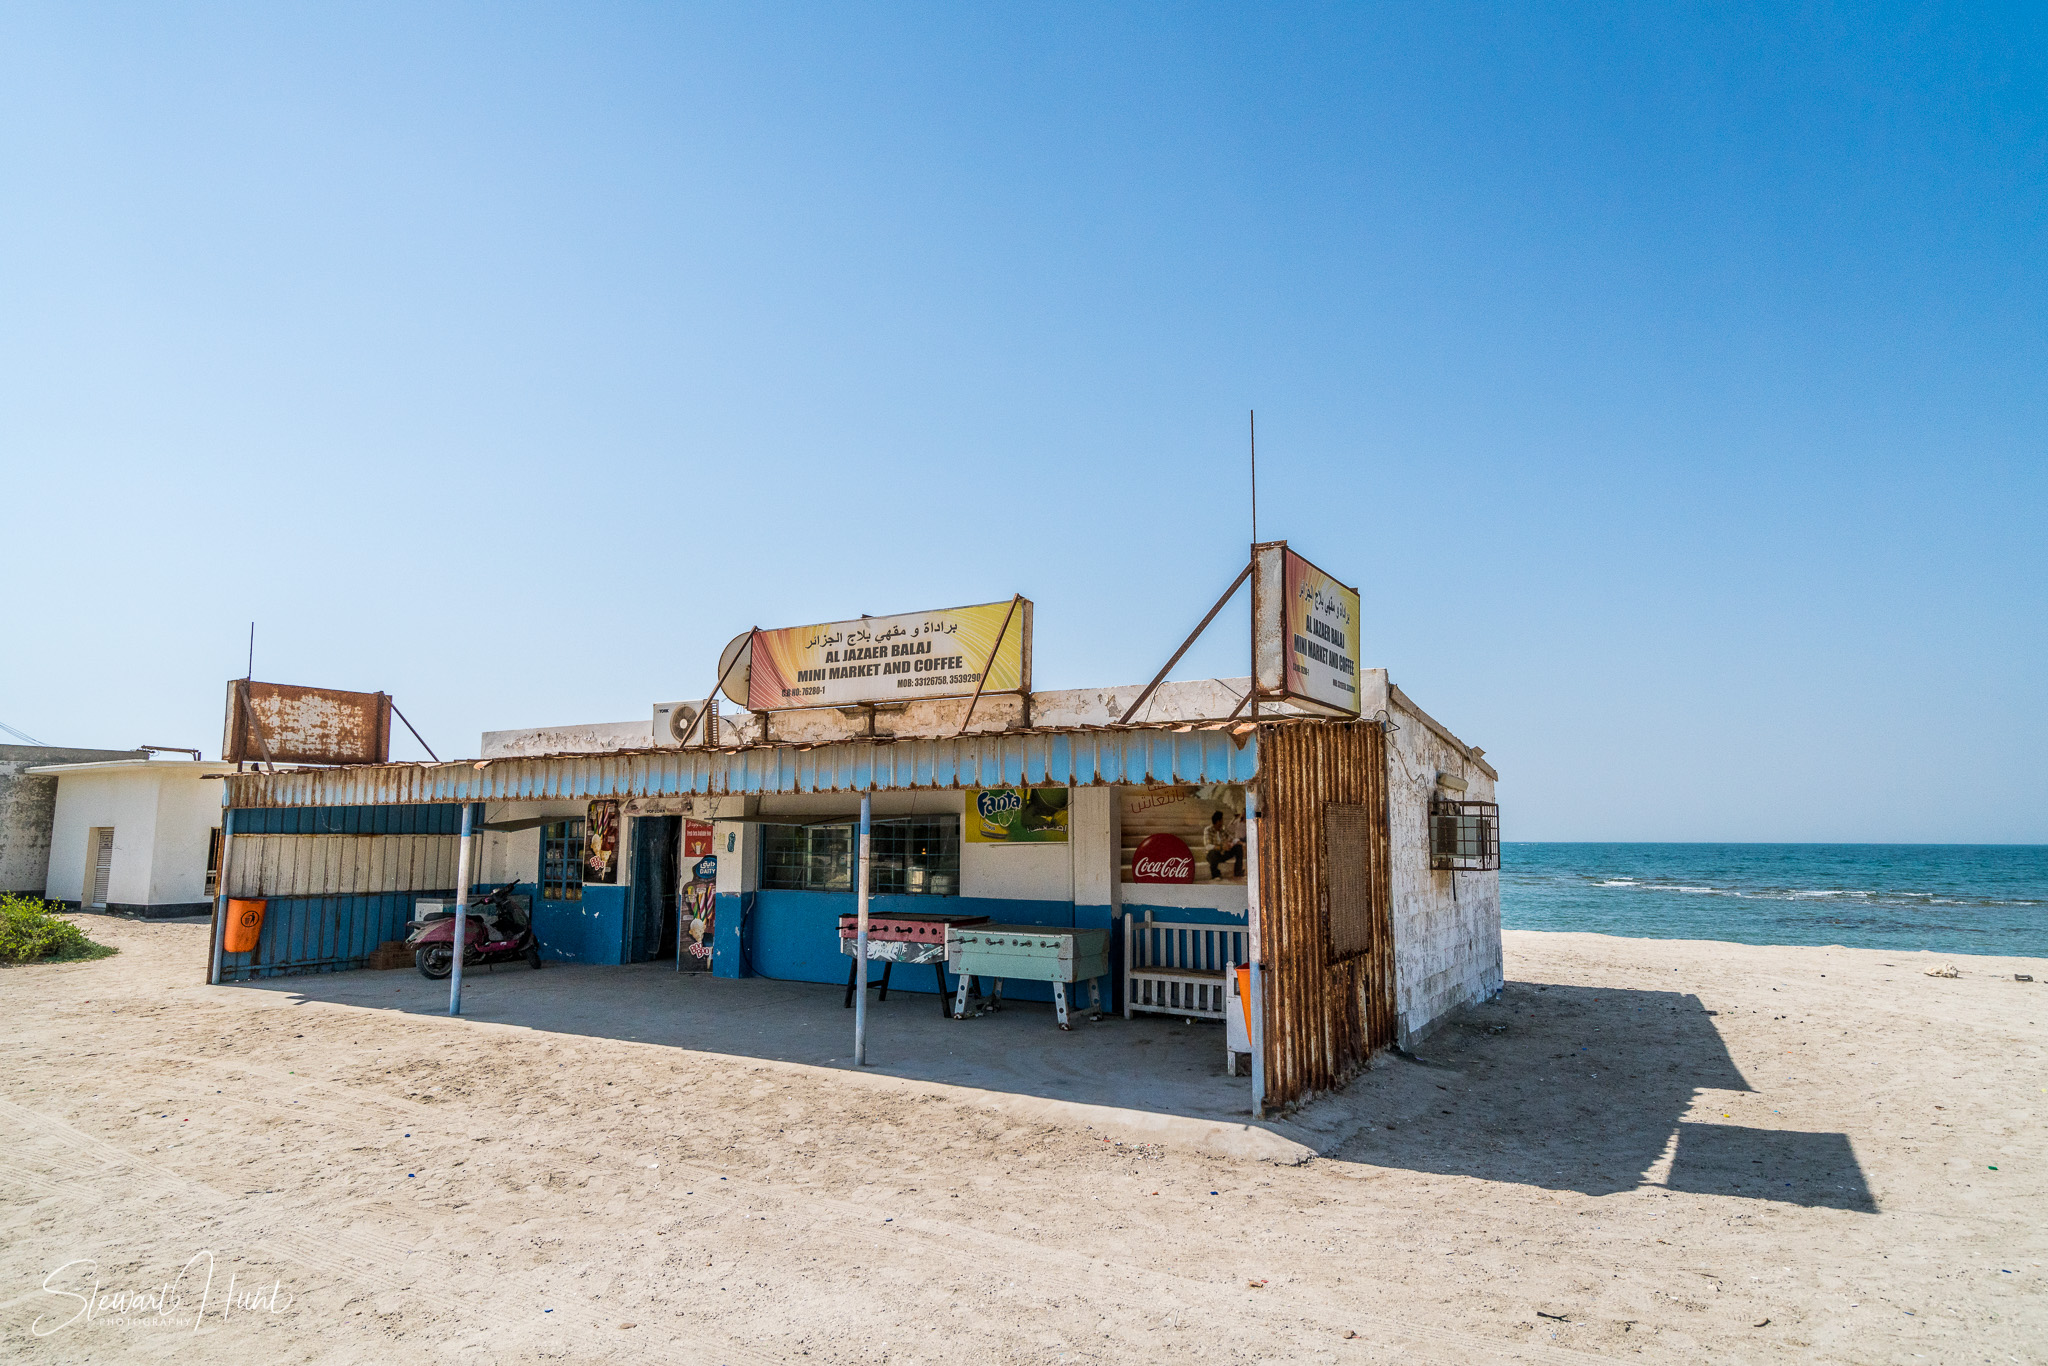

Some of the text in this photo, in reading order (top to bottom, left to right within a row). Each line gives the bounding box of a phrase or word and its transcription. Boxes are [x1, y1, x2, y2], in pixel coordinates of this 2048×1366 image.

[911, 627, 919, 637] و
[923, 620, 958, 635] براداة
[1306, 614, 1345, 649] AL JAZAER BALAJ
[805, 632, 843, 649] الجزائر
[847, 629, 871, 647] بلاج
[825, 641, 932, 663] AL JAZAER BALAJ
[1294, 633, 1354, 676] MINI MARKET AND COFFEE
[797, 655, 963, 682] MINI MARKET AND COFFEE
[802, 685, 826, 696] 76280-1
[897, 679, 914, 688] MOB:
[914, 676, 948, 687] 33126758,
[977, 789, 1022, 818] Fanta
[1135, 857, 1192, 878] Coca-Cola
